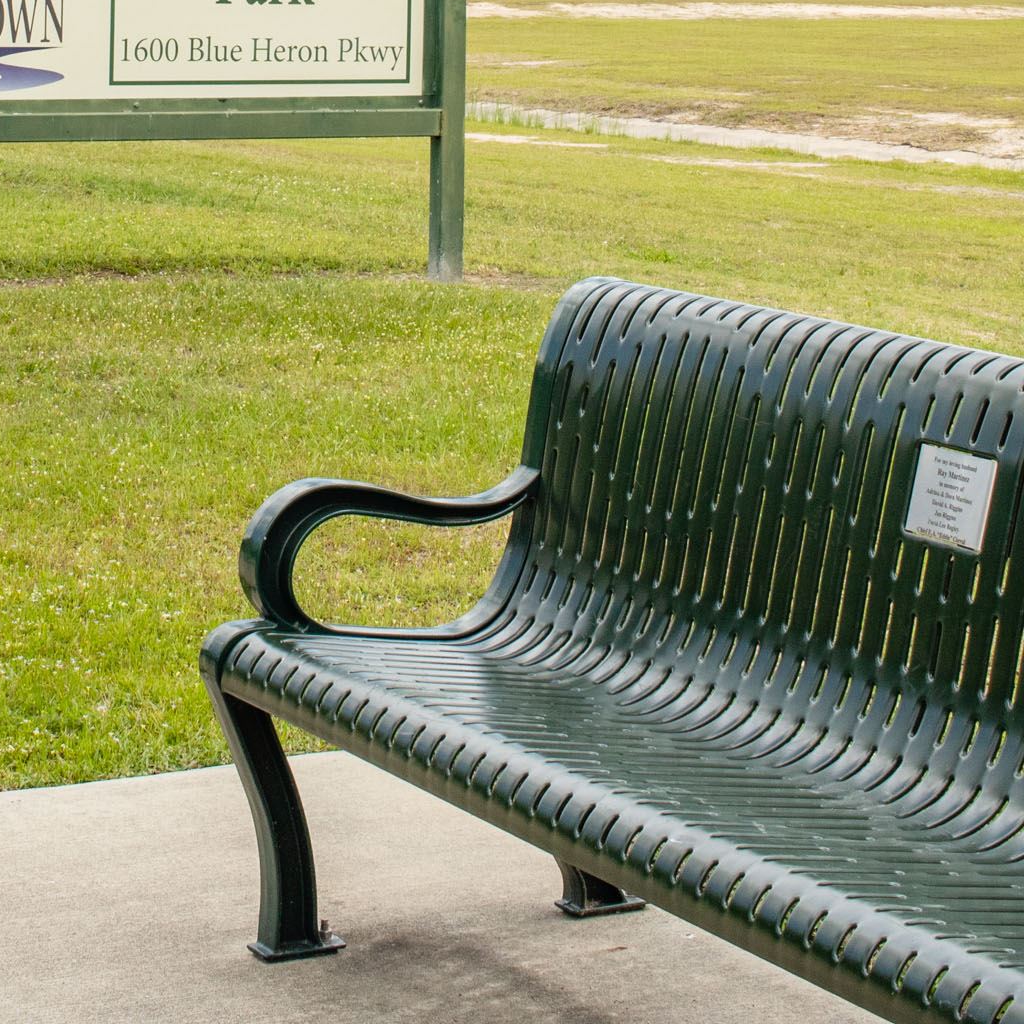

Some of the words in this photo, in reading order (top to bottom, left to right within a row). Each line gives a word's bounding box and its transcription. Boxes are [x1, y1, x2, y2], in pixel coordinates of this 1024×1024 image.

[120, 38, 179, 62] 1600
[187, 36, 243, 63] Blue
[250, 37, 329, 63] Heron
[337, 37, 405, 71] Pkwy
[938, 468, 947, 478] Ray
[949, 471, 969, 482] Martinez
[944, 483, 958, 491] memory
